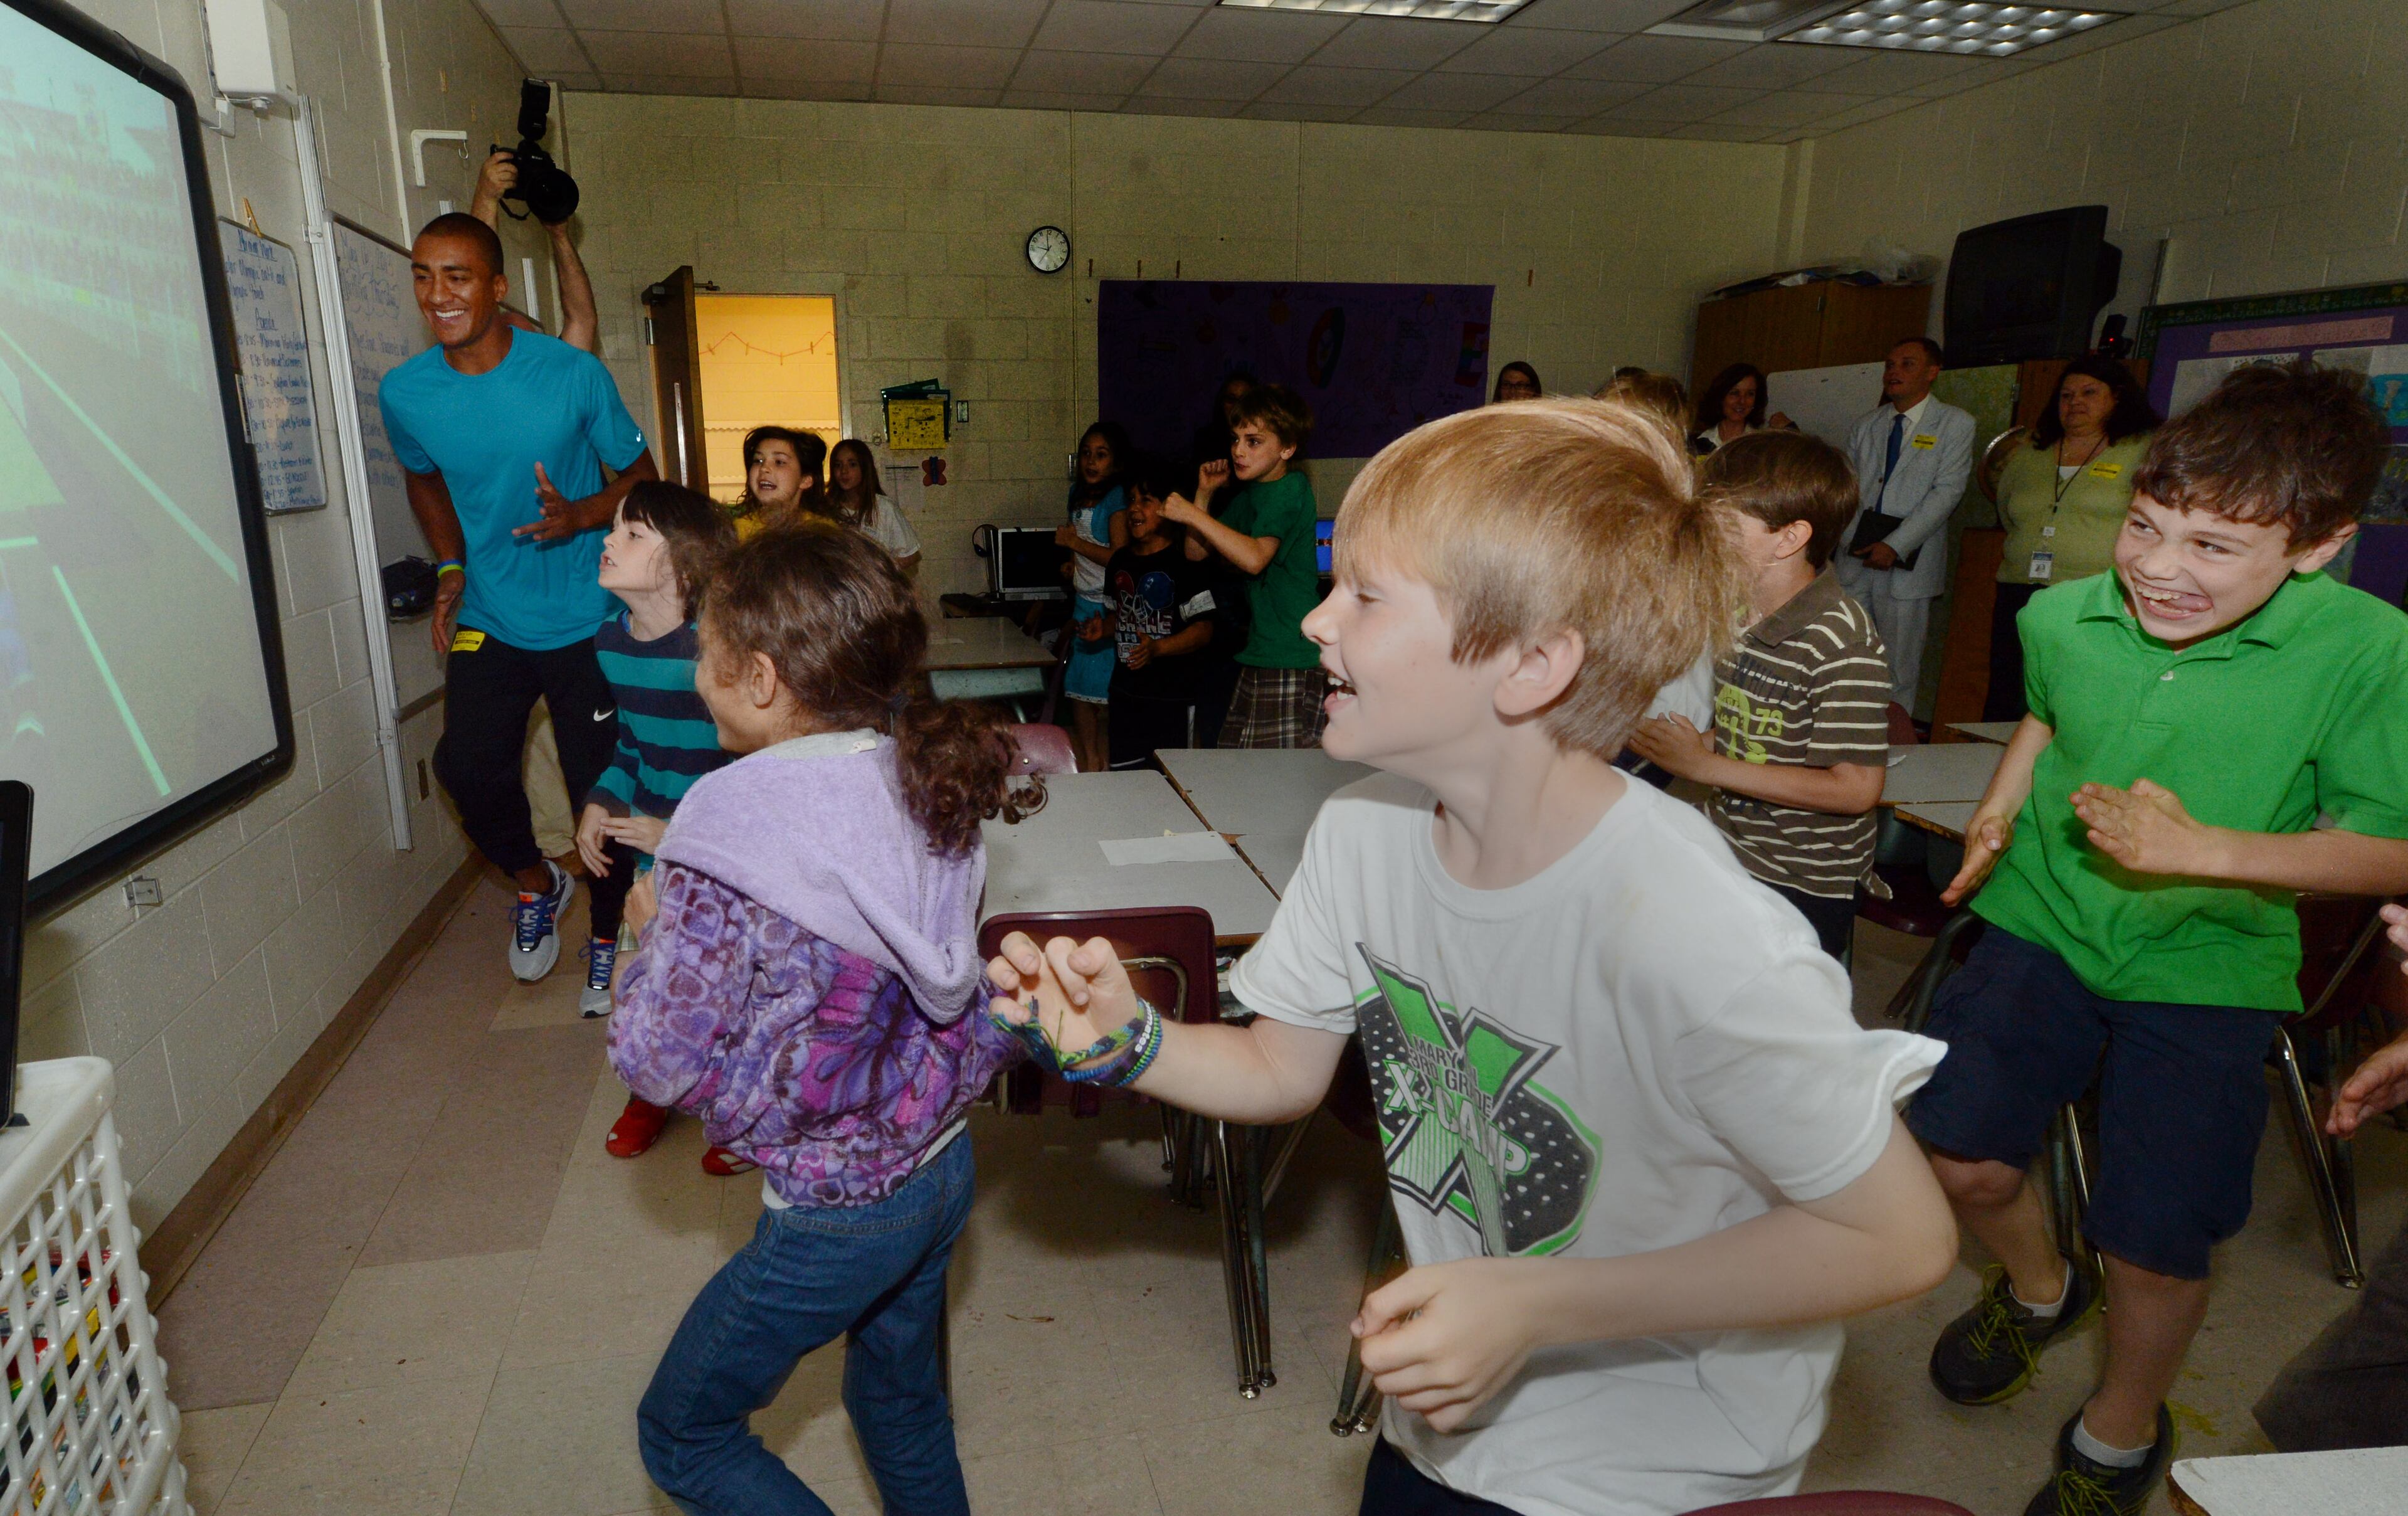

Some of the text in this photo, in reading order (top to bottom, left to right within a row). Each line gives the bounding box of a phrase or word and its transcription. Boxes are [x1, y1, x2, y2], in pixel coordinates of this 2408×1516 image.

[1755, 707, 1783, 736] 73
[1413, 1035, 1459, 1069] MARY
[1408, 1050, 1439, 1081] 3RD
[1445, 1068, 1493, 1119] GRDE
